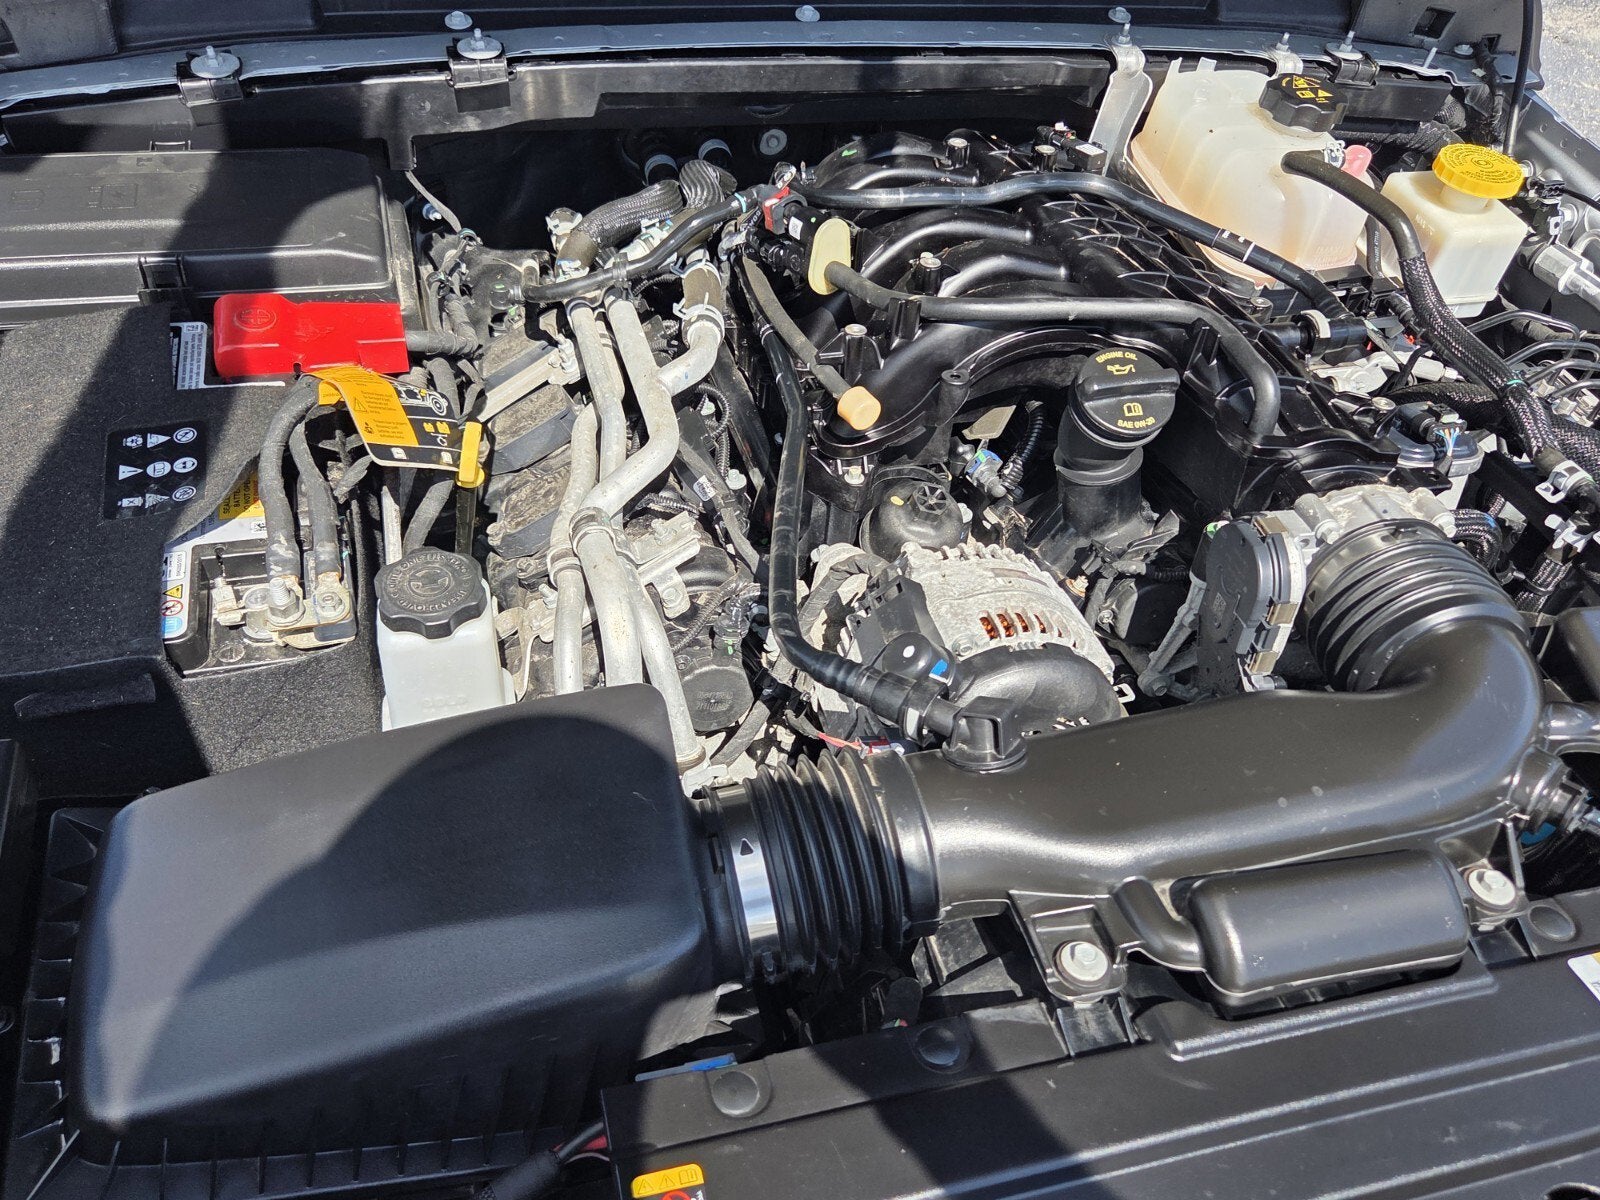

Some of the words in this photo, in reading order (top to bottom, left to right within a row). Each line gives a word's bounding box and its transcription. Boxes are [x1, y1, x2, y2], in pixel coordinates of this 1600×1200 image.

[1096, 351, 1123, 363] ENGINE
[1124, 352, 1138, 361] OIL
[1117, 419, 1134, 429] SAE
[1134, 416, 1156, 429] 0W-20
[243, 493, 251, 504] NOT
